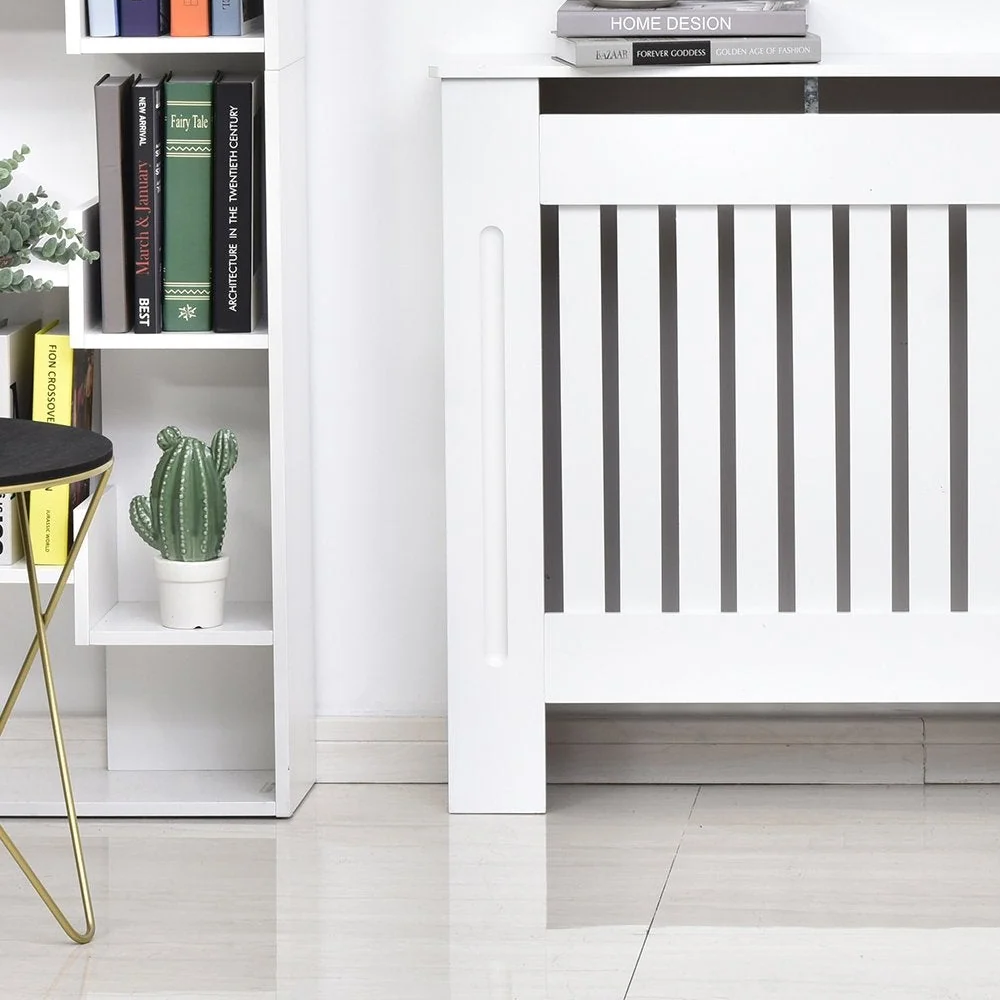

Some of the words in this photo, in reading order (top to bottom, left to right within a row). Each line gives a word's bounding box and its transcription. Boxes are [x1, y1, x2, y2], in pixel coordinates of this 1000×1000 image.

[611, 16, 661, 30] HOME
[667, 16, 732, 30] DESION
[596, 50, 628, 60] BAZAAR
[636, 50, 669, 58] FOREVER
[778, 46, 810, 54] FASHION
[170, 115, 190, 132] Fairy
[192, 115, 208, 128] Tale
[229, 105, 239, 149] CENTURY
[229, 150, 238, 202] TWENTIETH
[134, 161, 152, 214] January
[135, 216, 149, 229] &
[229, 206, 238, 224] THE
[228, 228, 238, 239] IN
[135, 232, 150, 275] March
[228, 243, 238, 312] ARCHITECTURE
[138, 298, 150, 326] BEST
[48, 344, 57, 368] FION
[46, 370, 56, 423] CROSSOVE
